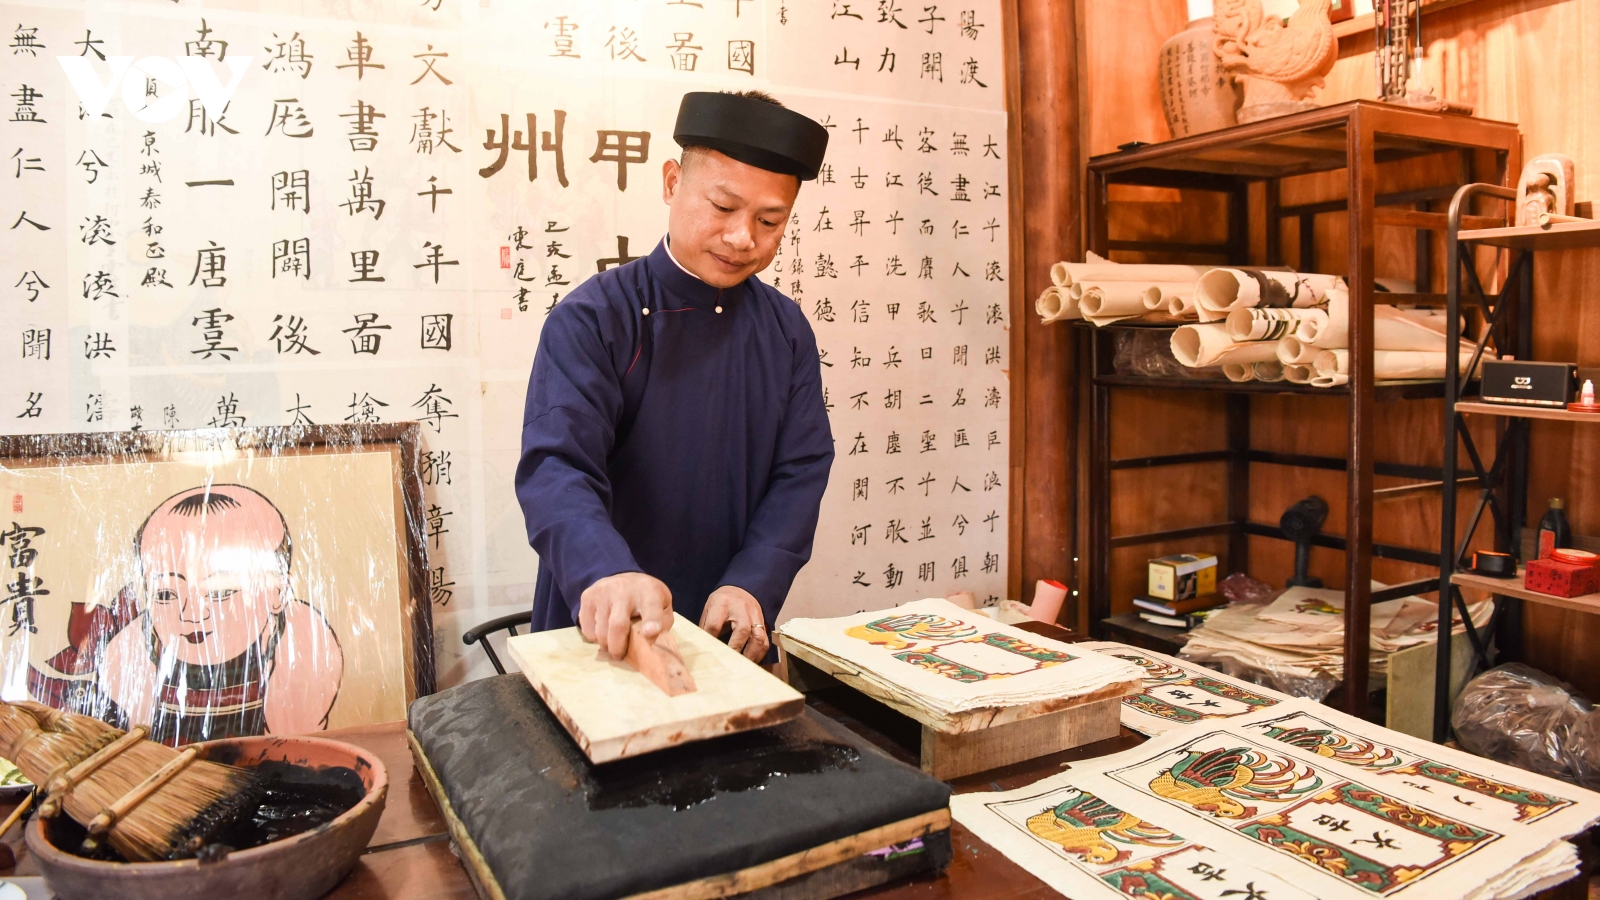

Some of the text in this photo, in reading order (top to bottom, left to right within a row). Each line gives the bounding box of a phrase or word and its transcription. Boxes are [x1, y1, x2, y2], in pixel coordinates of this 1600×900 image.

[604, 25, 647, 62] 後
[831, 0, 864, 70] 江山
[878, 0, 908, 72] 致力
[0, 521, 51, 637] 富貴
